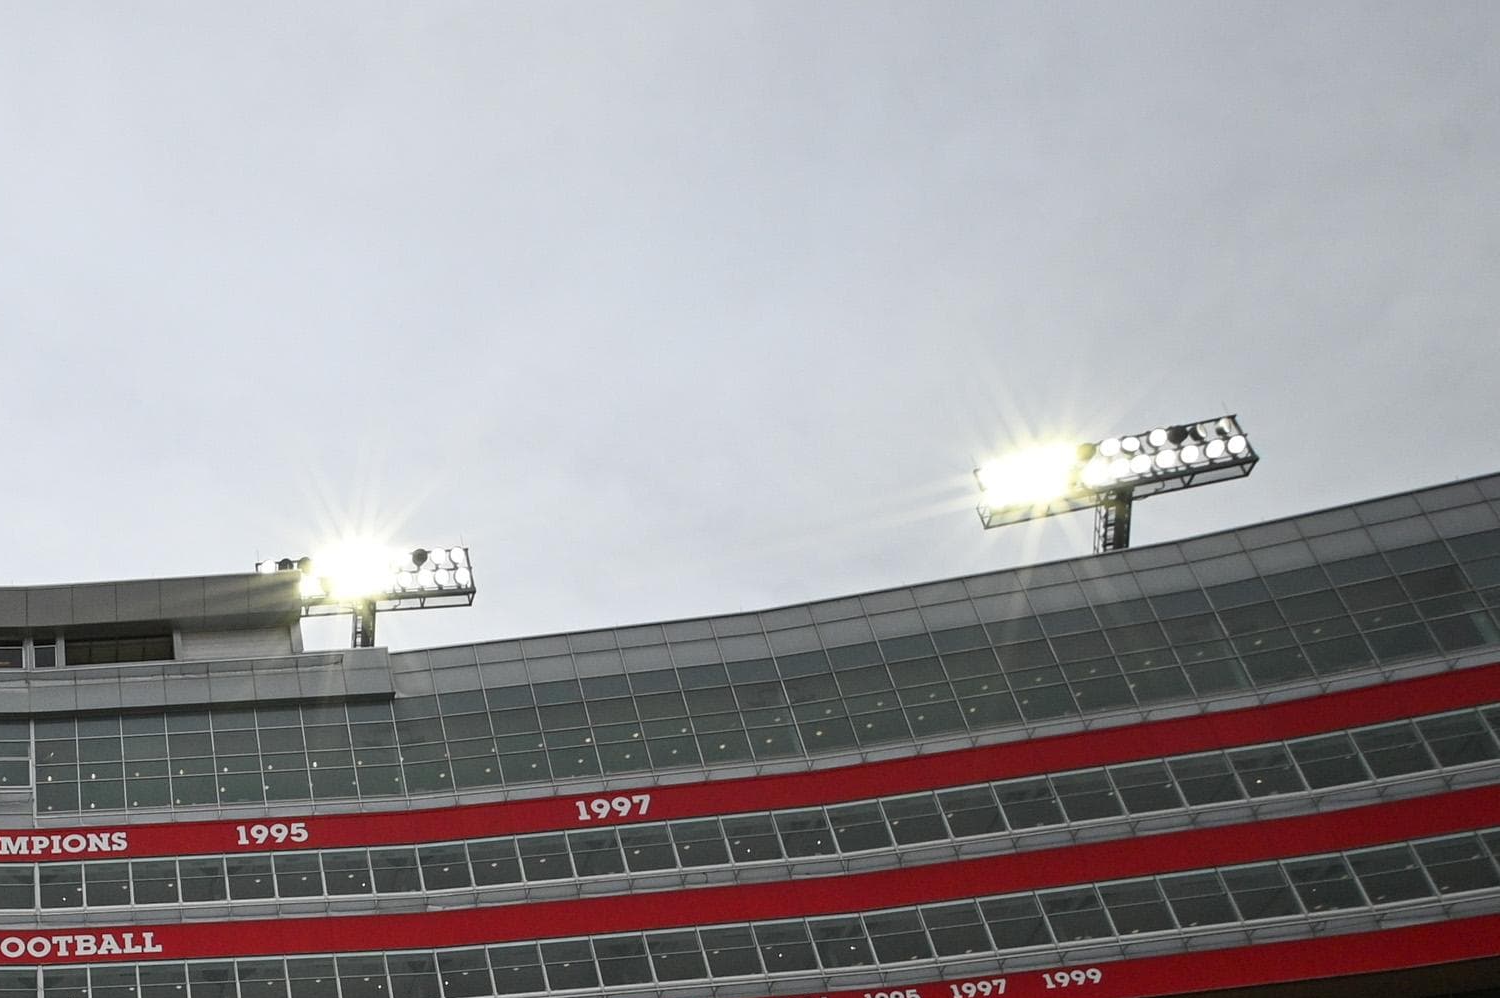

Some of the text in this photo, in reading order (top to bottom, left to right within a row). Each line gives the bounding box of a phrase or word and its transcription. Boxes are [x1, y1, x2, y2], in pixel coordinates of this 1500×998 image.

[575, 794, 651, 821] 1997
[236, 822, 309, 845] 1995
[1042, 967, 1102, 989] 1999
